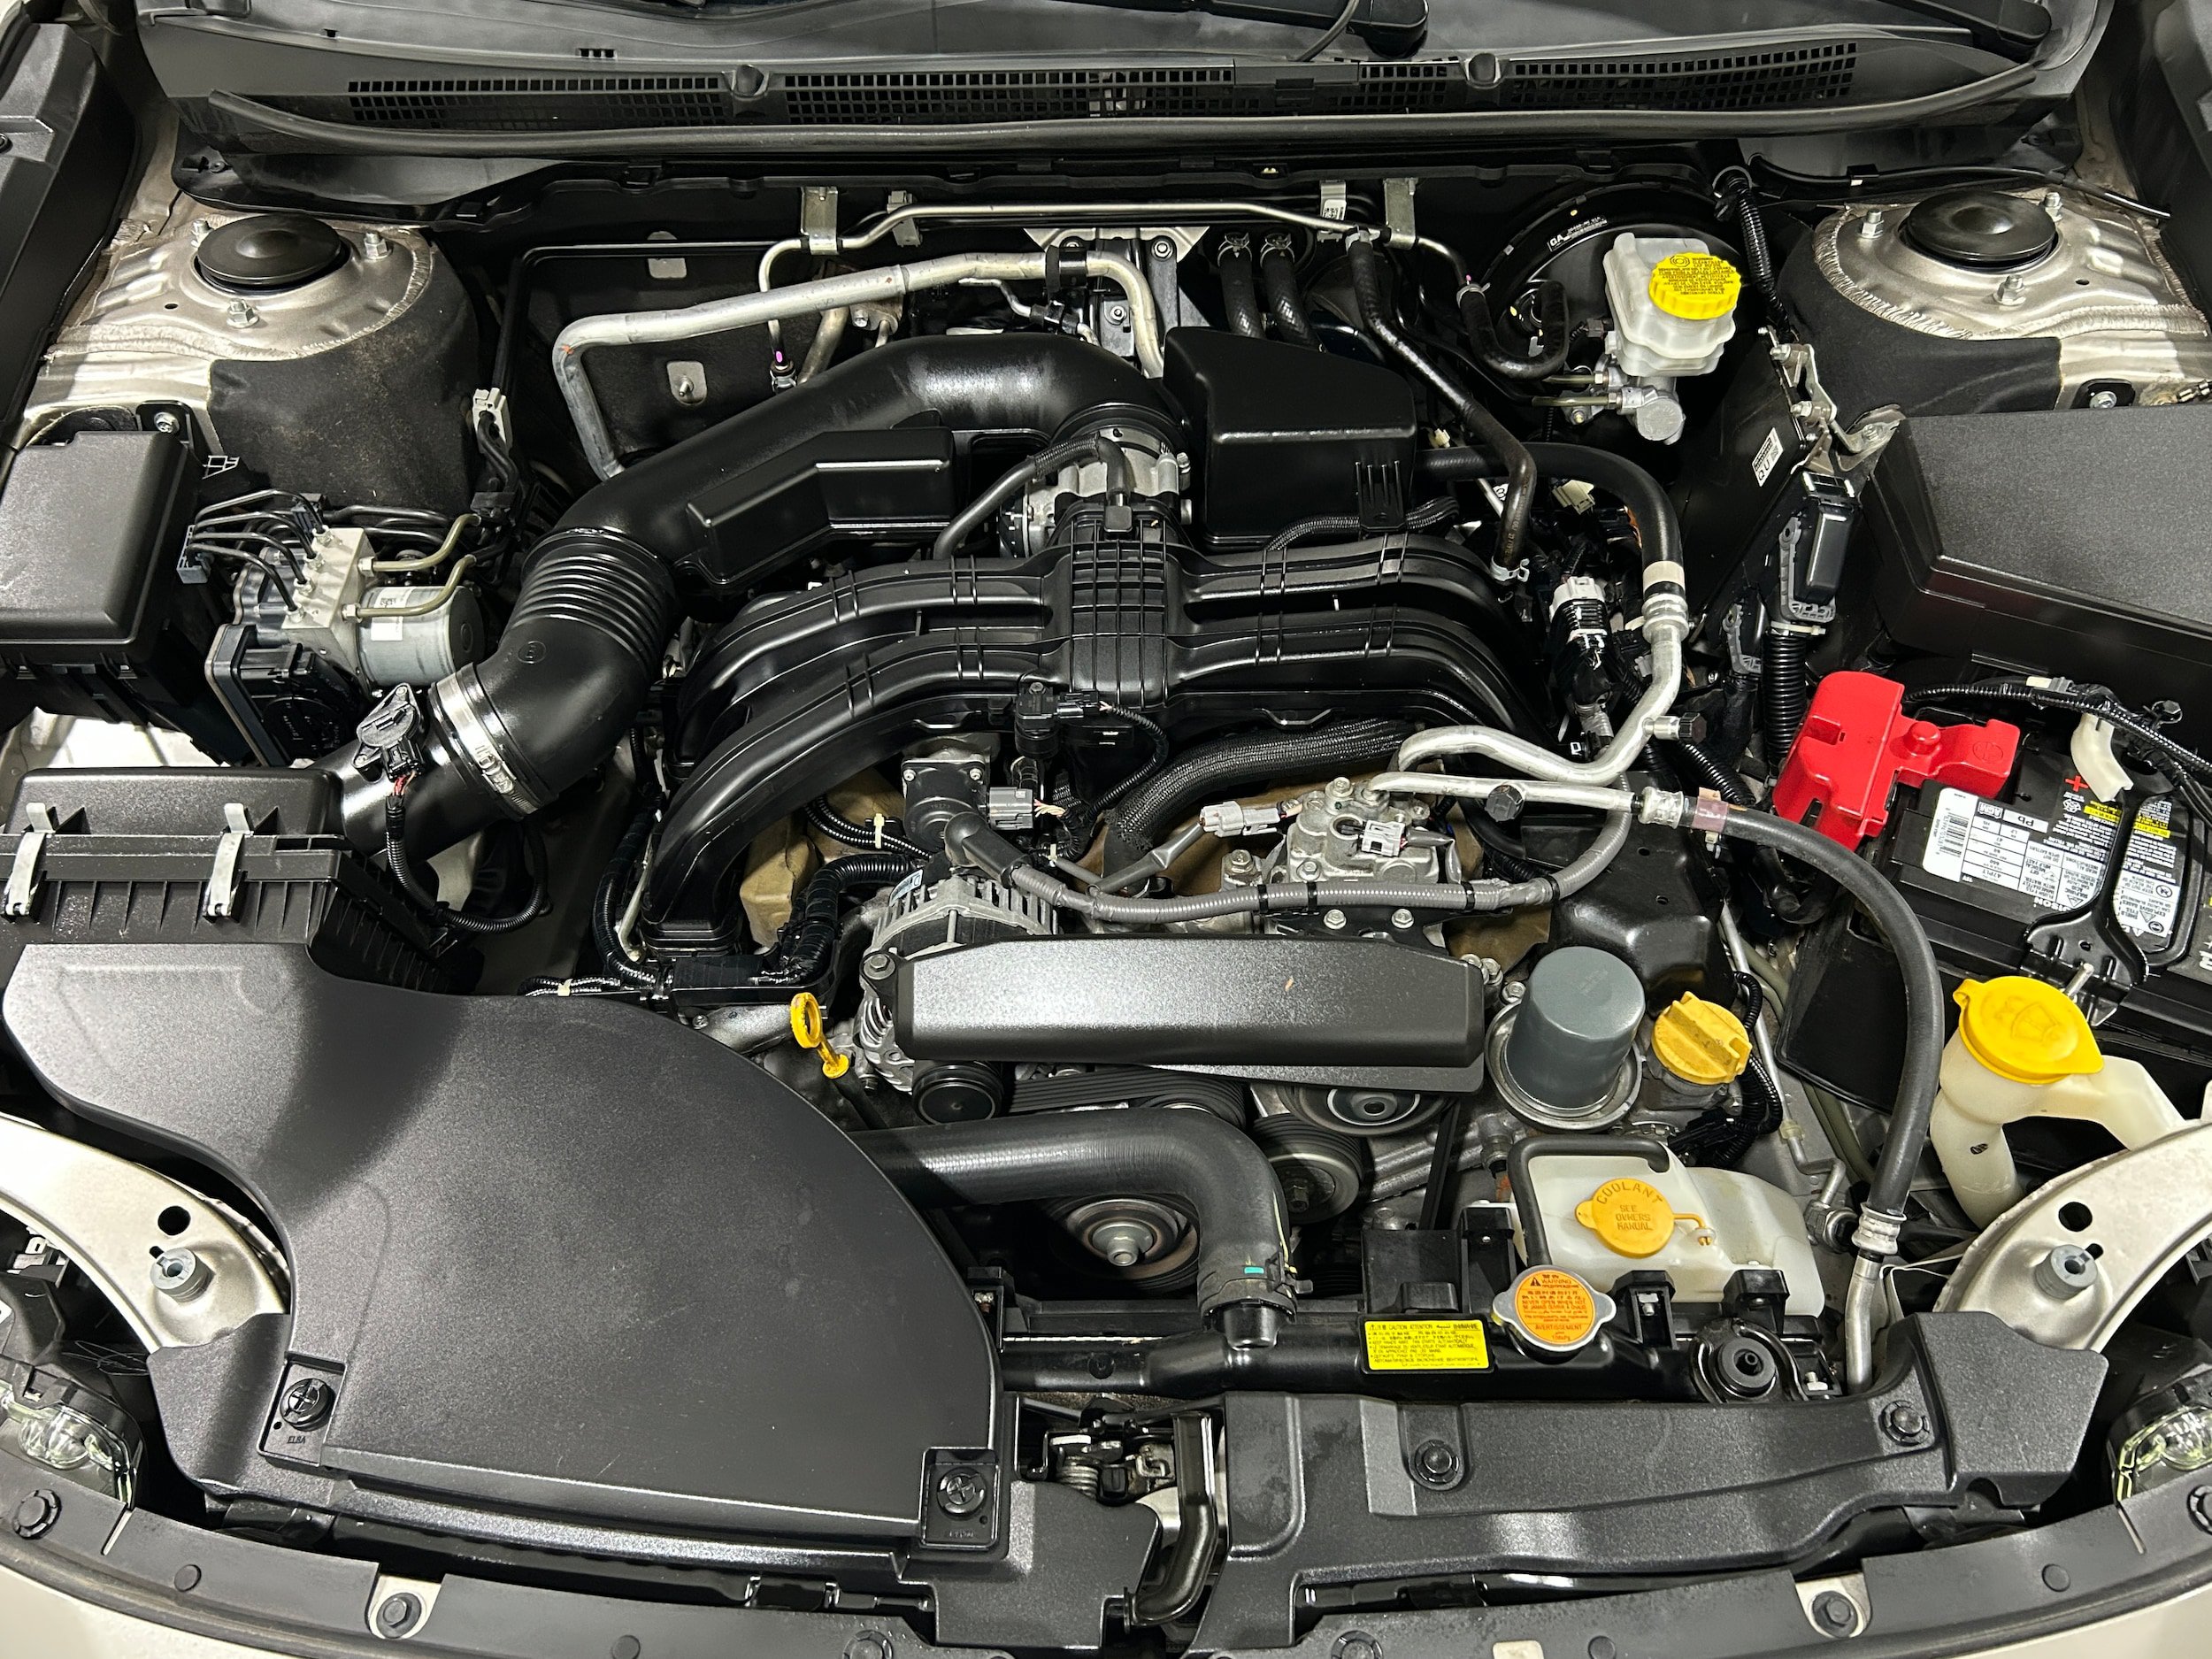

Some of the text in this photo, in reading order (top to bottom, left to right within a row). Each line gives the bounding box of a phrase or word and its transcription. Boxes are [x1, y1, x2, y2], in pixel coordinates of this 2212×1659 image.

[2016, 815, 2034, 826] Pb
[1596, 1181, 1663, 1204] COOLANT
[1616, 1213, 1651, 1222] OWNERS
[1617, 1222, 1654, 1232] MANUAL
